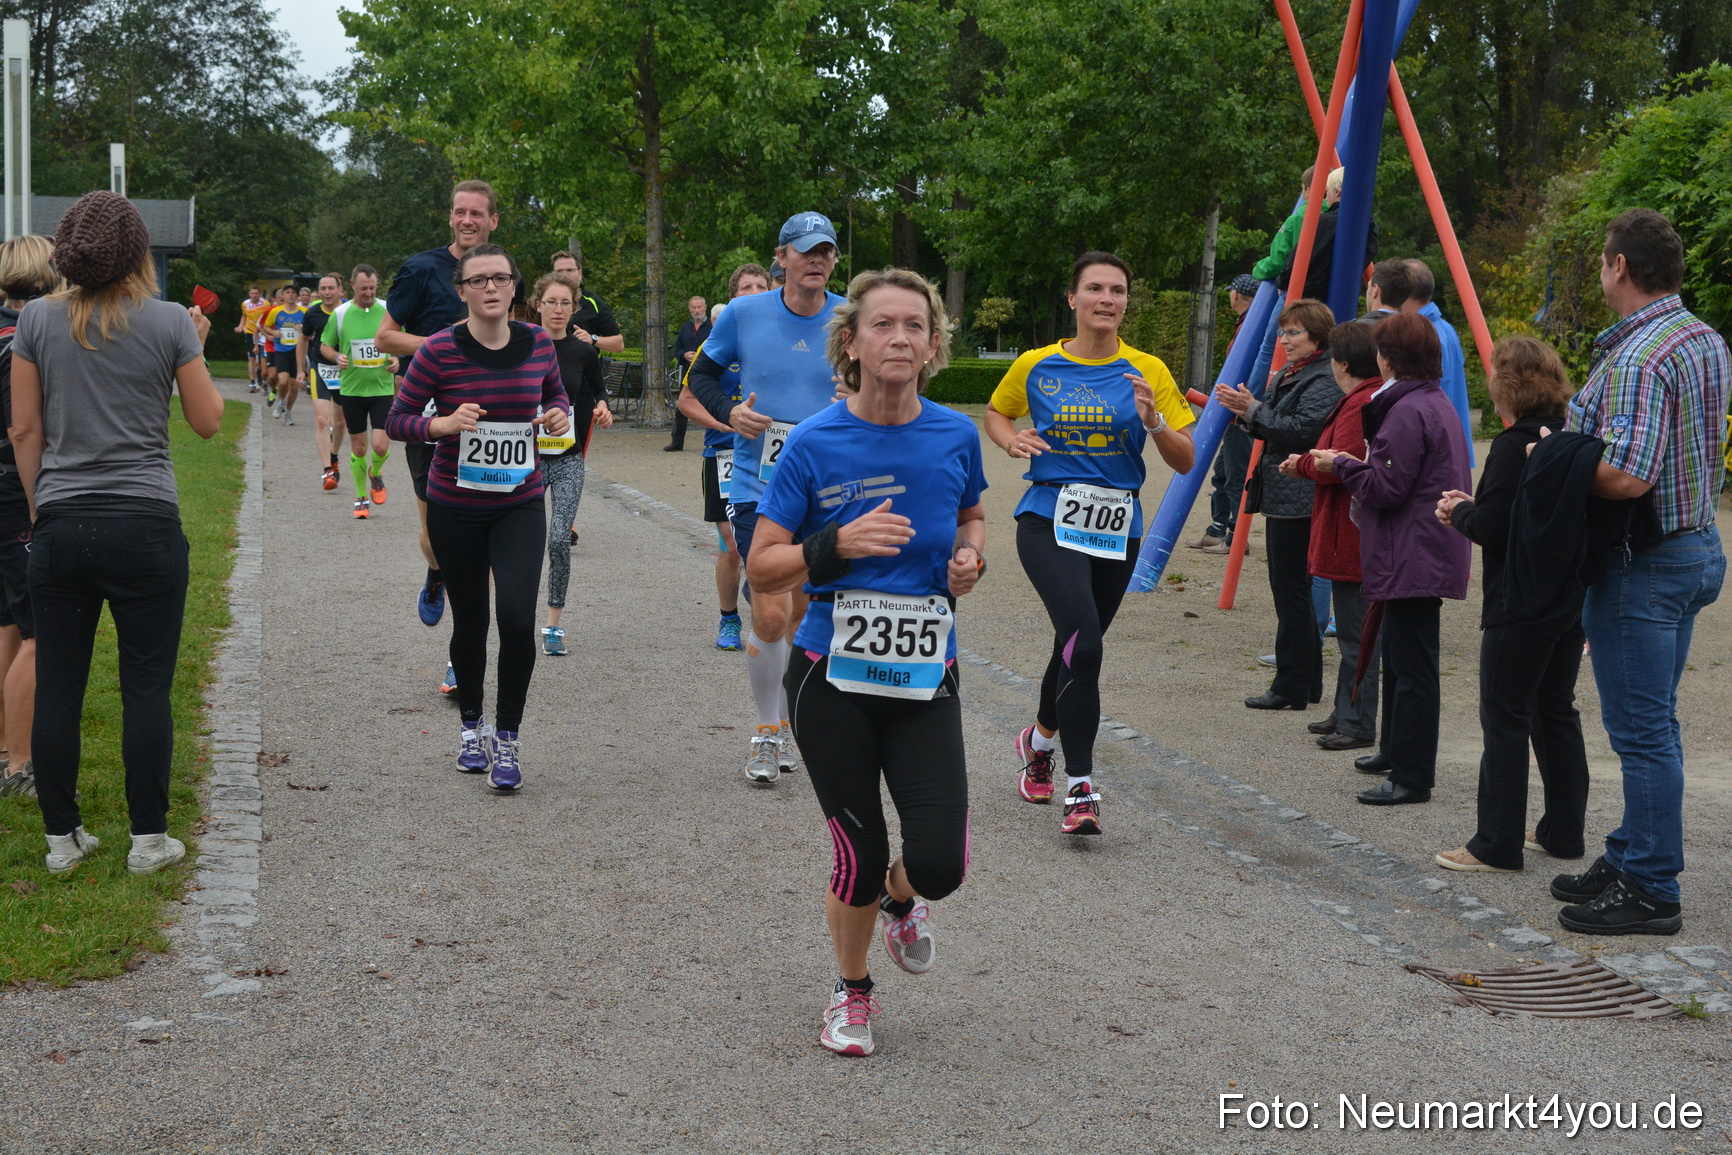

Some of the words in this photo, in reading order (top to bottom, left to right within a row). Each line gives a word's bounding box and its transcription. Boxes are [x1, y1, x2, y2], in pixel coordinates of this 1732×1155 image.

[359, 346, 380, 358] 195
[766, 427, 789, 437] PARTL
[467, 437, 527, 465] 2900
[769, 438, 784, 463] 2
[480, 471, 512, 482] Judith
[723, 461, 734, 479] 2
[1062, 488, 1088, 499] PARTL
[1089, 493, 1122, 504] Neumarkt
[1061, 499, 1126, 531] 2108
[1064, 531, 1117, 549] Anna-Maria
[837, 599, 876, 610] PARTL
[879, 600, 933, 613] Neumarkt
[843, 614, 941, 658] 2355
[866, 665, 911, 687] Helga
